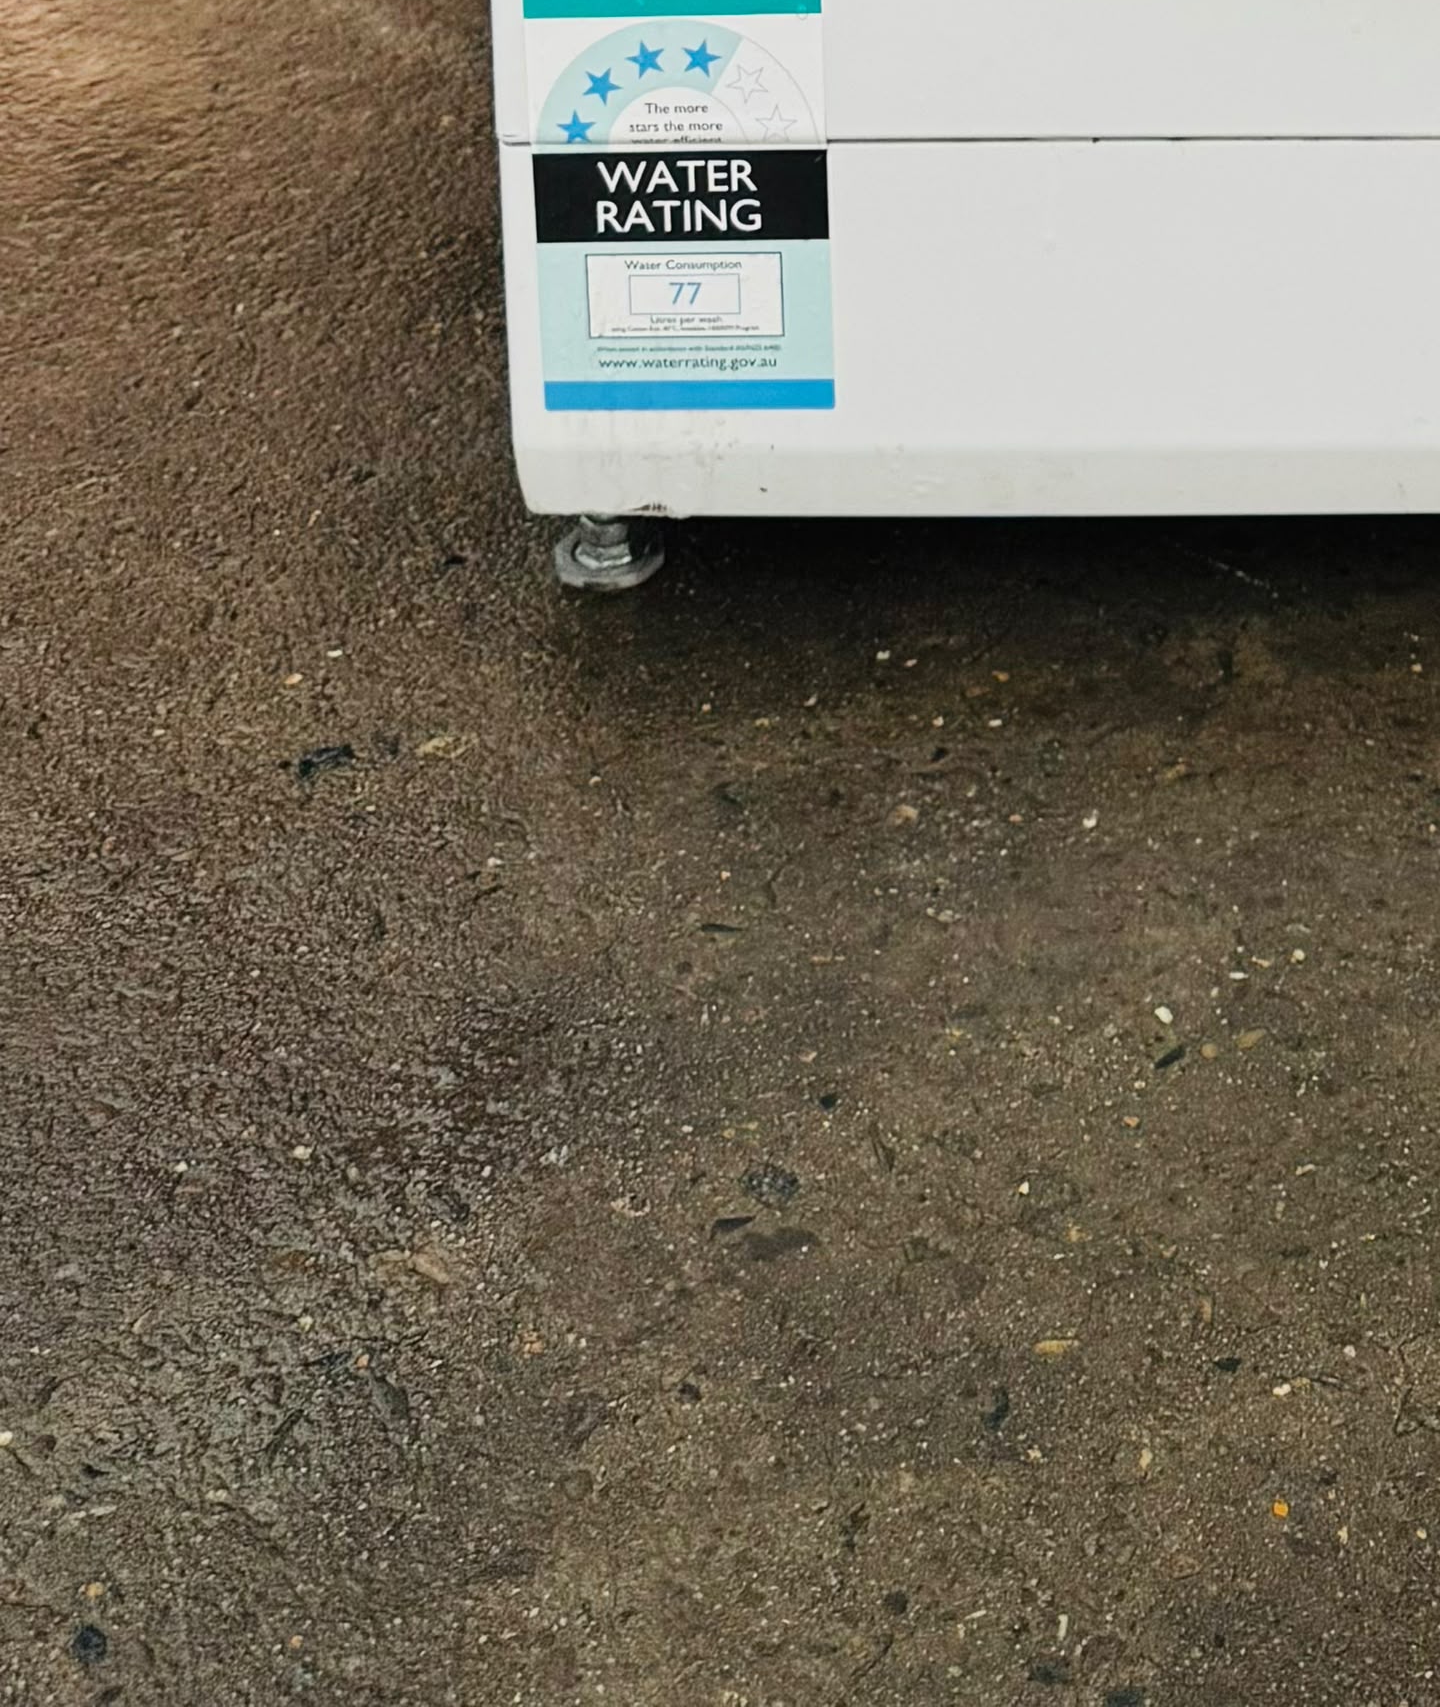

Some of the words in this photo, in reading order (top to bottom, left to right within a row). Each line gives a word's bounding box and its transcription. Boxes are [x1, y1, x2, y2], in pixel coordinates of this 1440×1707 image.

[644, 102, 670, 115] The
[673, 104, 709, 115] more
[629, 122, 660, 133] stars
[663, 120, 685, 133] the
[688, 122, 724, 132] more
[597, 159, 758, 194] WATER
[597, 198, 763, 234] RATING
[624, 259, 662, 271] Water
[665, 259, 743, 272] Consumption
[667, 281, 703, 306] 77
[598, 355, 778, 372] www.waterrating.gov.au
